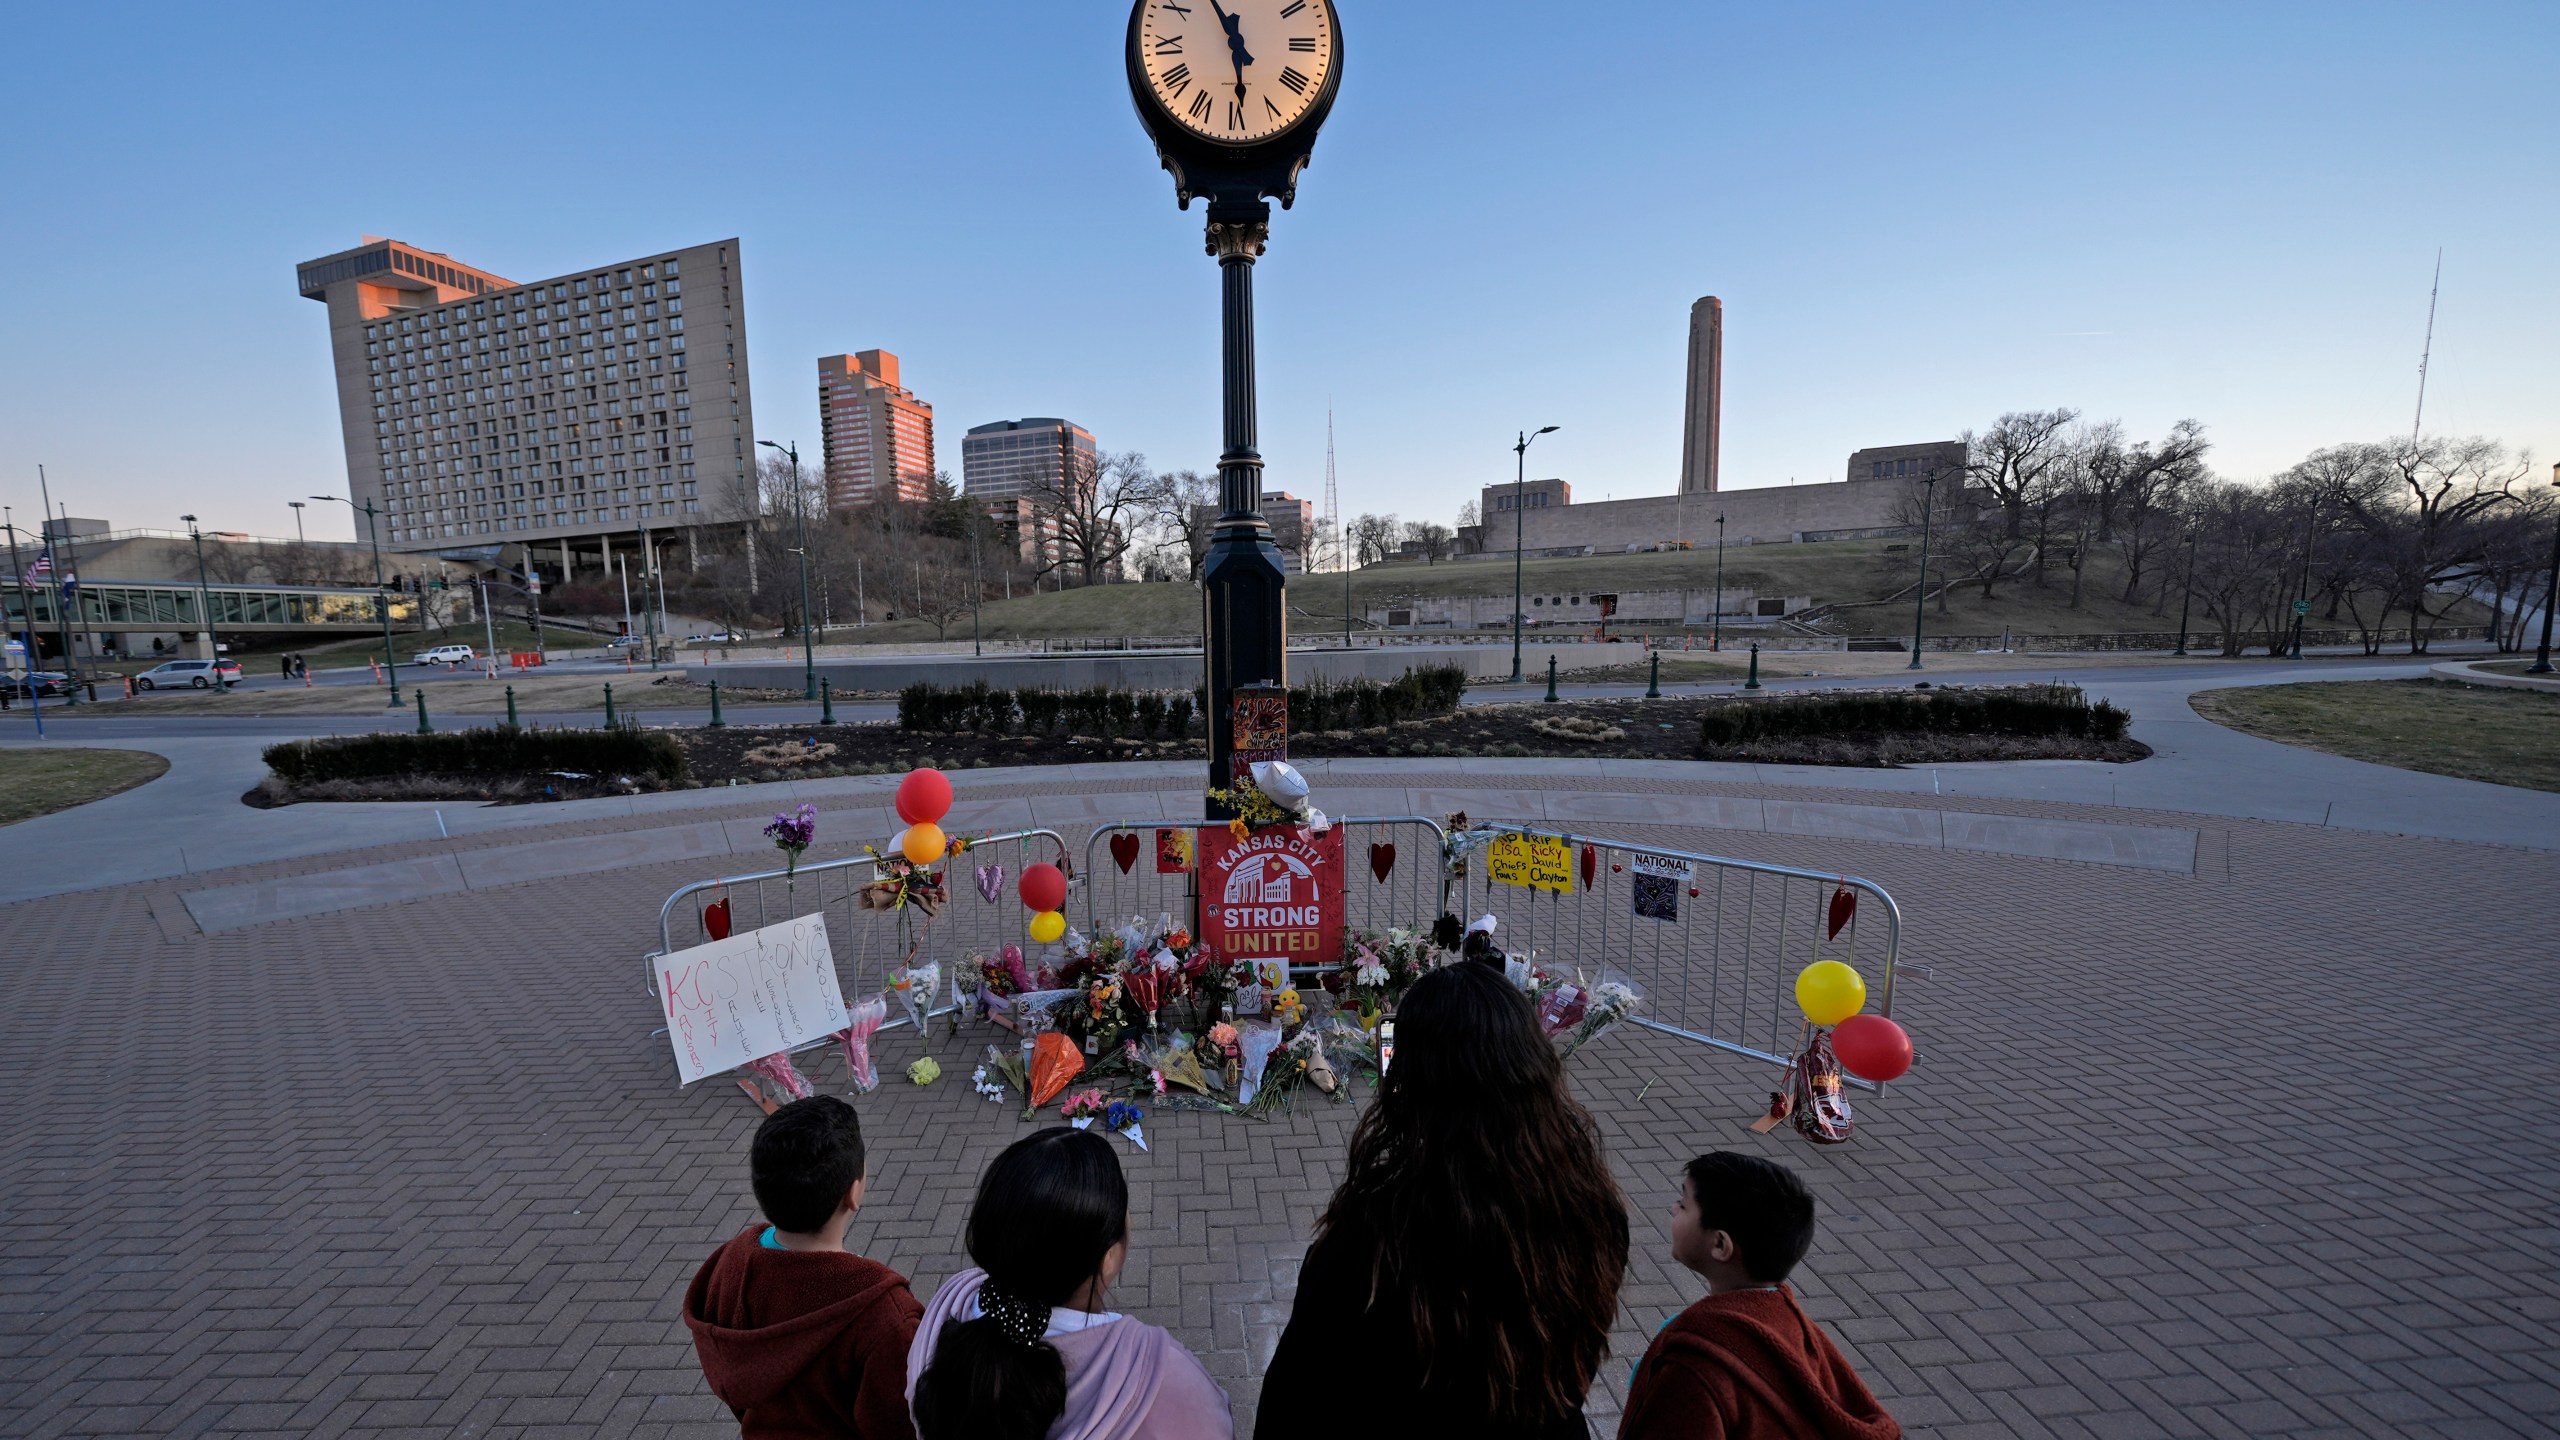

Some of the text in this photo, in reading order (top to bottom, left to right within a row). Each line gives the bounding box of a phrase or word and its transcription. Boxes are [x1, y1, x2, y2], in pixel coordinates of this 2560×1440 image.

[1289, 38, 1315, 52] III
[1161, 62, 1193, 99] VIII
[1278, 66, 1309, 96] IIII
[1188, 89, 1213, 124] VII
[1263, 94, 1282, 122] V
[1216, 835, 1285, 872] KANSAS
[1288, 839, 1326, 868] CITY
[1530, 844, 1562, 860] Ricky
[1532, 855, 1562, 869] David
[1635, 854, 1690, 871] NATIONAL
[1493, 858, 1527, 870] Chiefs
[1530, 868, 1568, 884] Clayton
[1224, 906, 1320, 928] STRONG
[1224, 931, 1320, 953] UNITED
